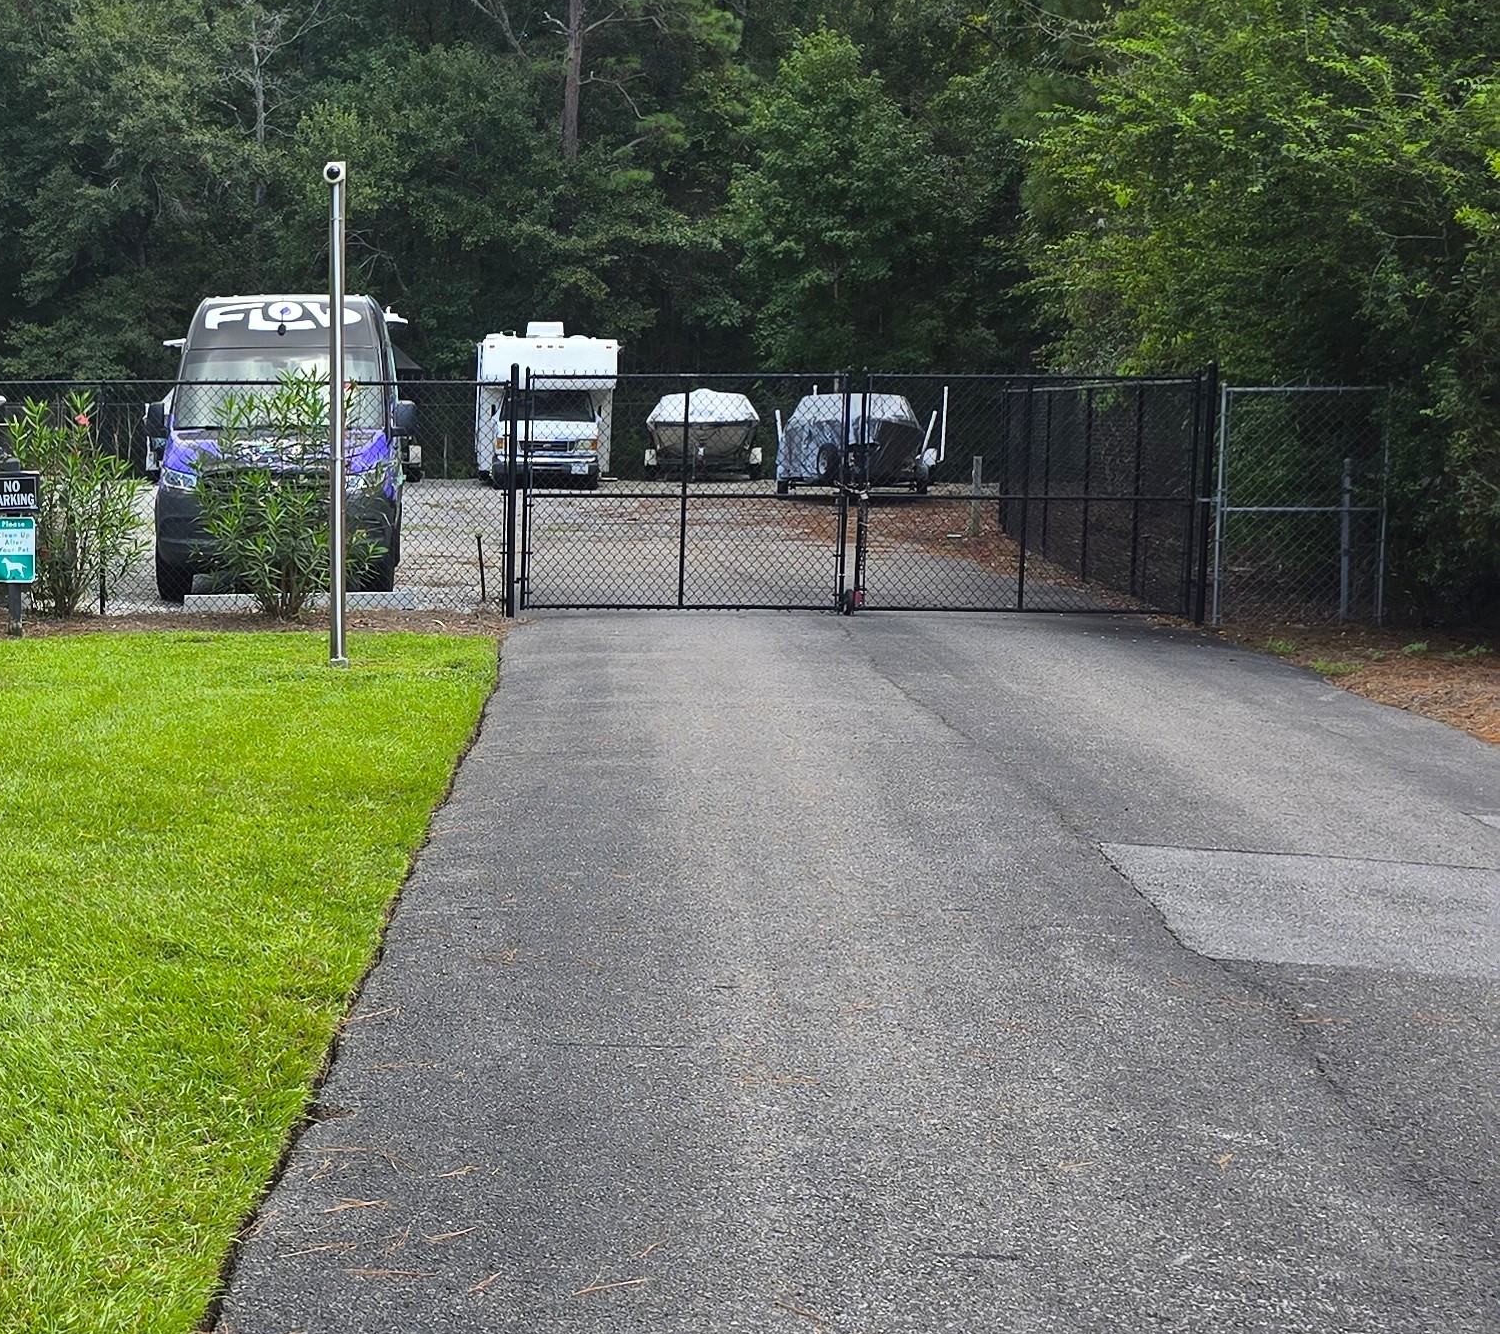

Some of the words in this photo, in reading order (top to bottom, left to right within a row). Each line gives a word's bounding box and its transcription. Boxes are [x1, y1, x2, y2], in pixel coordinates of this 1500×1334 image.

[3, 480, 20, 493] NO
[1, 520, 26, 528] Please
[20, 531, 31, 540] Up
